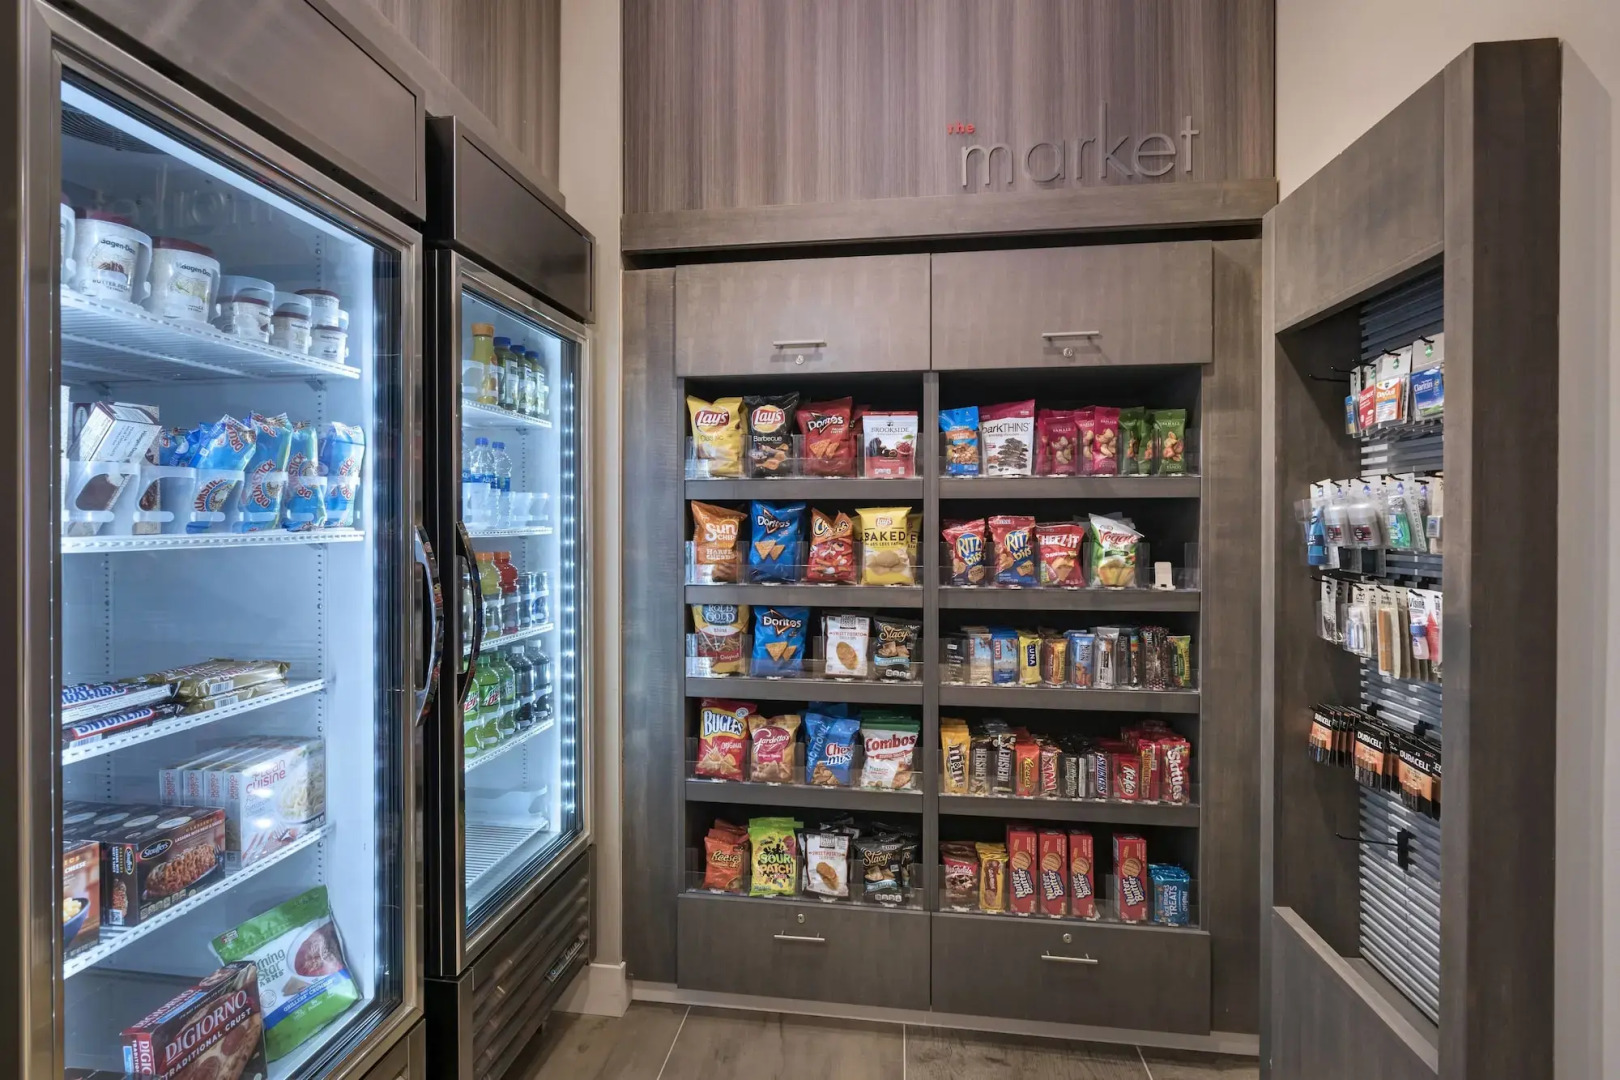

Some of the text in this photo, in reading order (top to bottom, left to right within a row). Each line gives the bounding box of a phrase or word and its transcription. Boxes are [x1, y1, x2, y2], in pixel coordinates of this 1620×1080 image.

[947, 120, 975, 134] the
[961, 101, 1200, 187] market
[1414, 381, 1433, 392] Claritin
[697, 410, 729, 426] Lay's
[754, 410, 783, 425] Lay's
[807, 414, 844, 432] Doritos
[982, 422, 1030, 434] barkTHINS
[252, 460, 276, 508] DRUMSTICK
[705, 518, 737, 541] Sun
[757, 516, 791, 528] Doritos
[864, 531, 906, 541] BAKED
[1005, 533, 1030, 552] RITZ
[1098, 529, 1139, 545] Veggie
[957, 536, 981, 556] RITZ
[708, 604, 735, 613] ROLD
[1409, 596, 1425, 609] Visine
[705, 612, 736, 623] GOLD
[763, 616, 802, 628] Doritos
[719, 653, 740, 661] Original
[703, 710, 744, 736] BUGLES
[1314, 712, 1332, 726] DURACELL
[753, 728, 789, 753] Gardetto's
[826, 742, 855, 756] Chex
[865, 734, 917, 752] Combos
[1357, 731, 1383, 750] DURACELL
[1399, 749, 1431, 772] DURACELL
[1042, 755, 1057, 791] TWIX
[1096, 756, 1107, 794] SNICKERS
[1167, 750, 1183, 800] Skittles
[143, 842, 169, 858] Stouffer's
[711, 849, 742, 867] Reese's
[759, 853, 791, 864] SOUR
[863, 850, 893, 867] Stacy's
[65, 861, 86, 874] CHEESE
[760, 863, 794, 874] PATCH
[1012, 872, 1025, 898] Nutter
[1019, 868, 1033, 895] Butter
[1042, 873, 1056, 901] Nutter
[1048, 870, 1064, 896] Butter
[1072, 876, 1085, 899] Nutter
[1078, 873, 1092, 896] Butter
[1129, 876, 1144, 902] Butter
[1122, 879, 1136, 906] Nutter
[1169, 886, 1178, 917] TREATS
[256, 949, 286, 970] rning
[259, 968, 284, 987] ARMS
[161, 1031, 223, 1080] TRADITIONAL
[225, 1007, 252, 1032] CRUST
